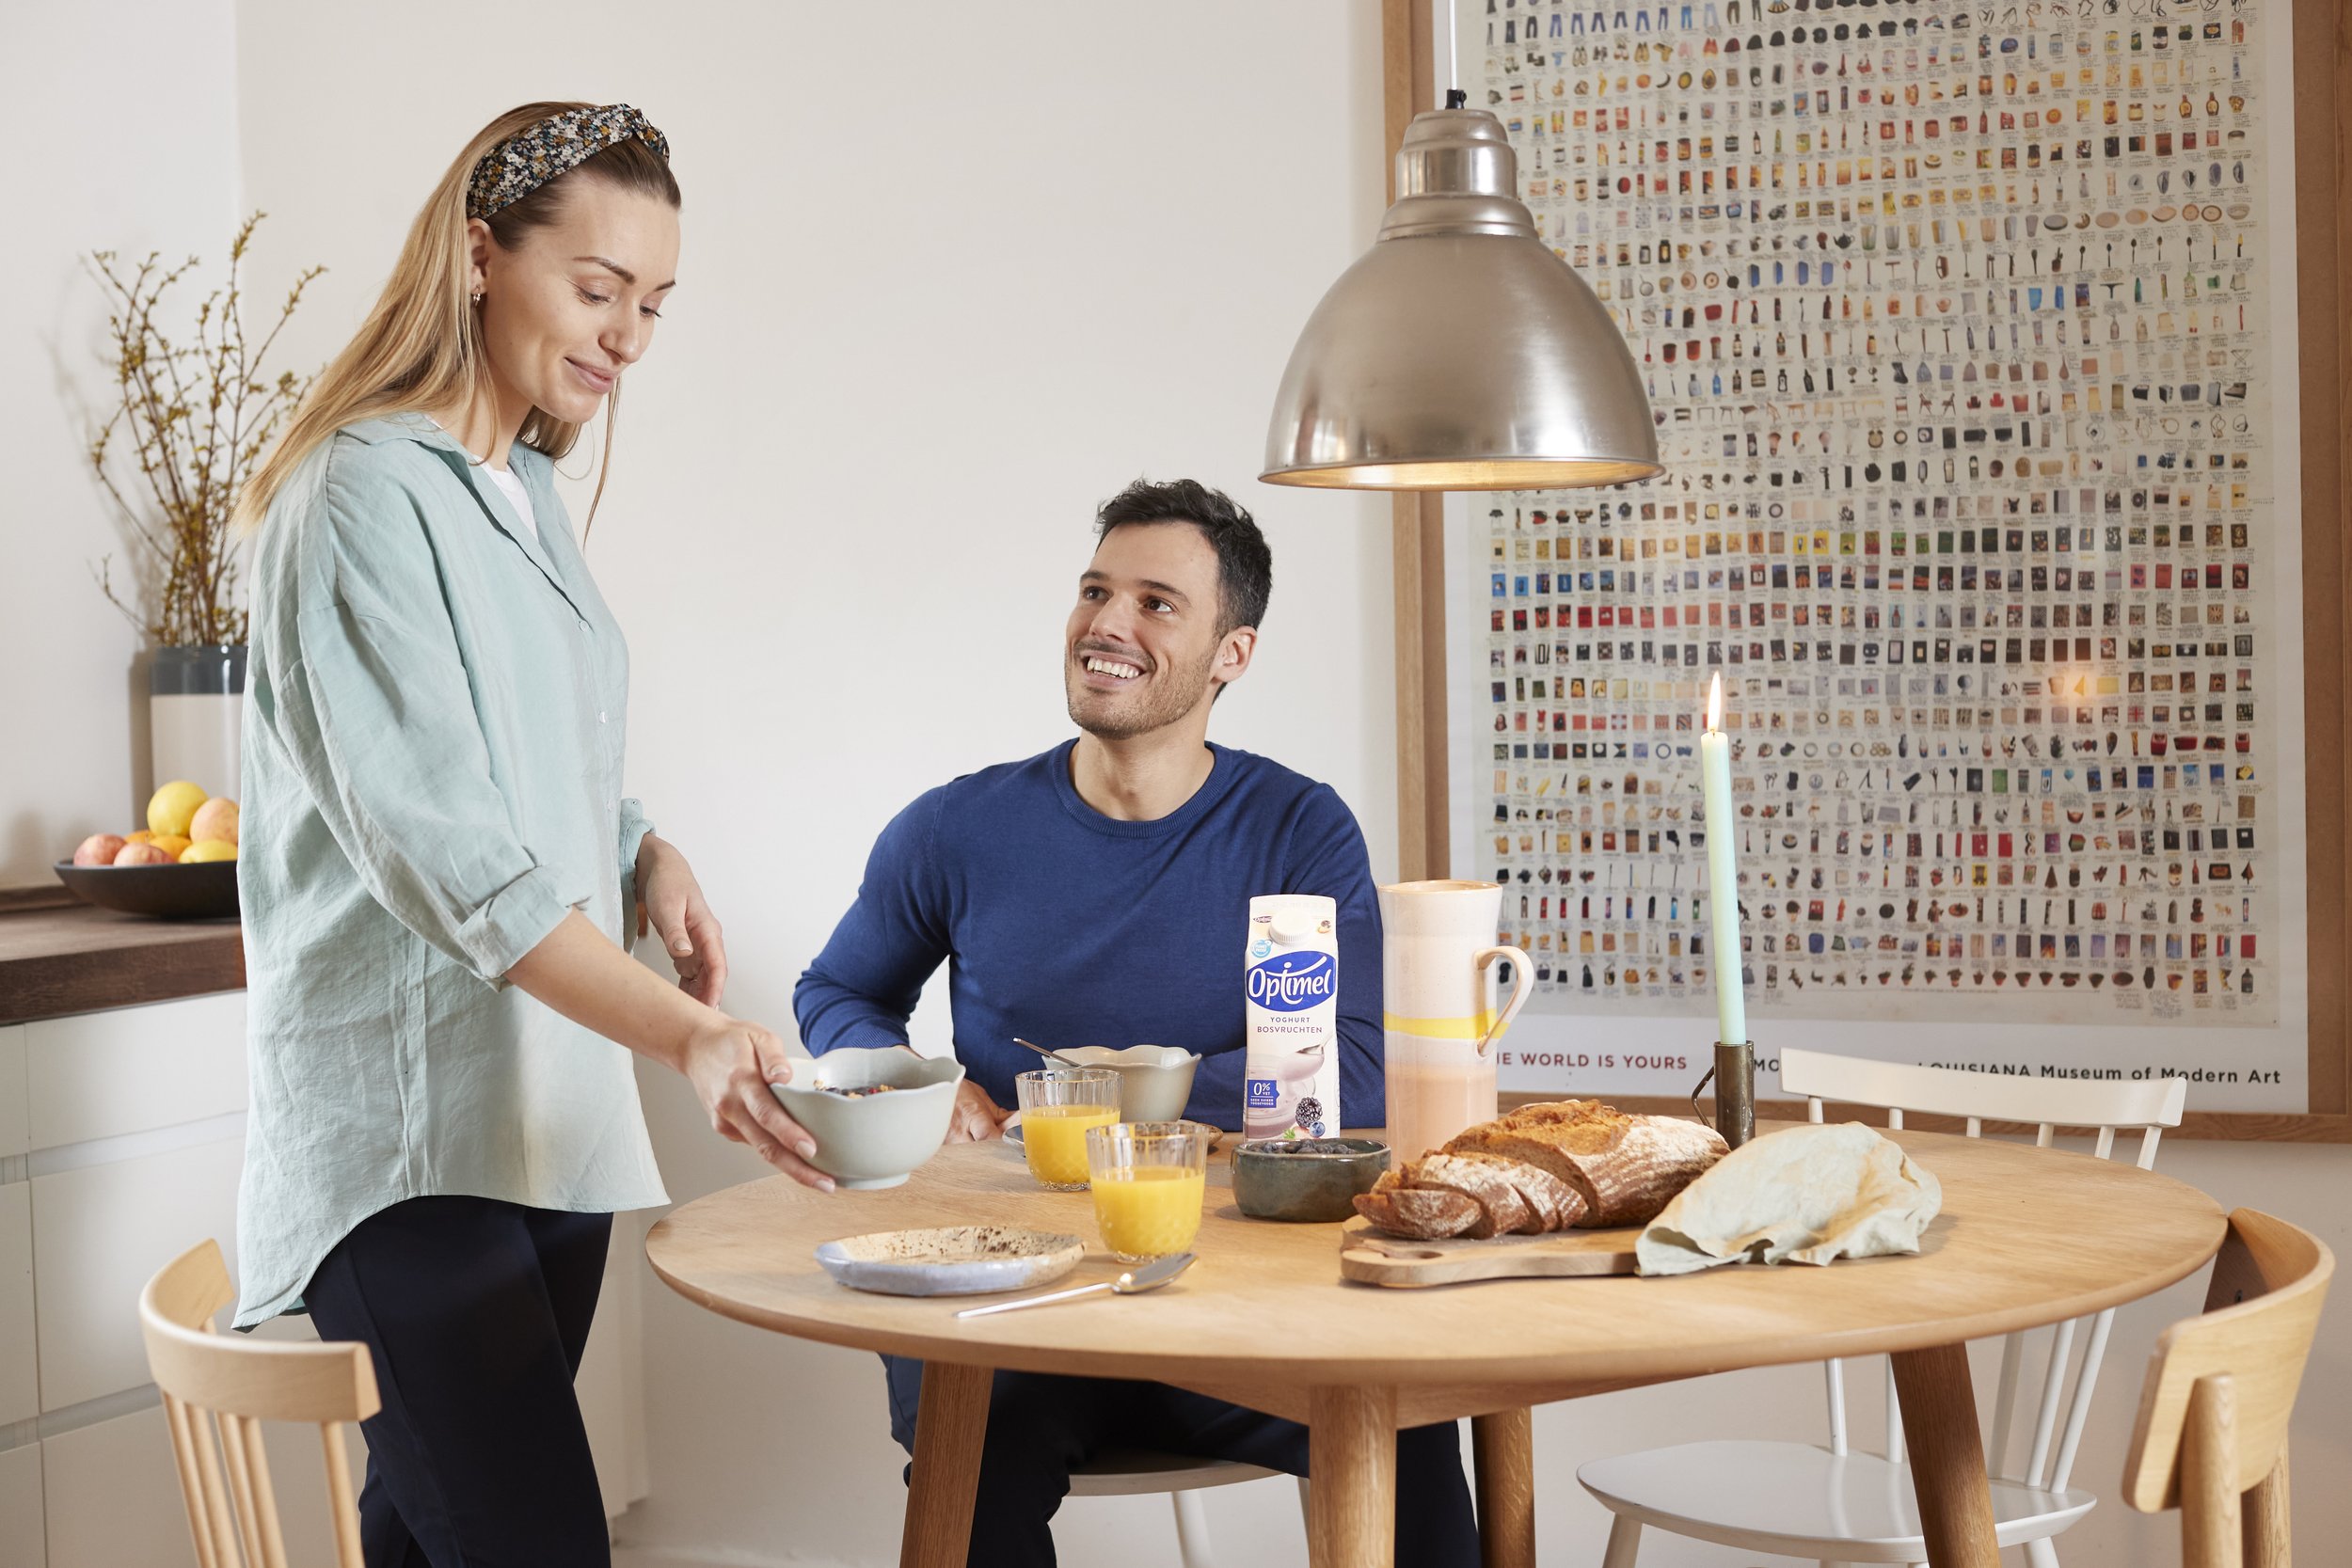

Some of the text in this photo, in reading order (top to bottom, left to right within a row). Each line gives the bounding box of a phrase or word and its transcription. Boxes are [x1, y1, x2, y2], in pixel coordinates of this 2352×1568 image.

[1248, 956, 1331, 1006] Optimel
[1520, 1053, 1590, 1068] WORLD
[1597, 1054, 1614, 1069] IS
[1623, 1055, 1687, 1069] YOURS
[1918, 1062, 2281, 1084] ISIANA Museum of Modern Art
